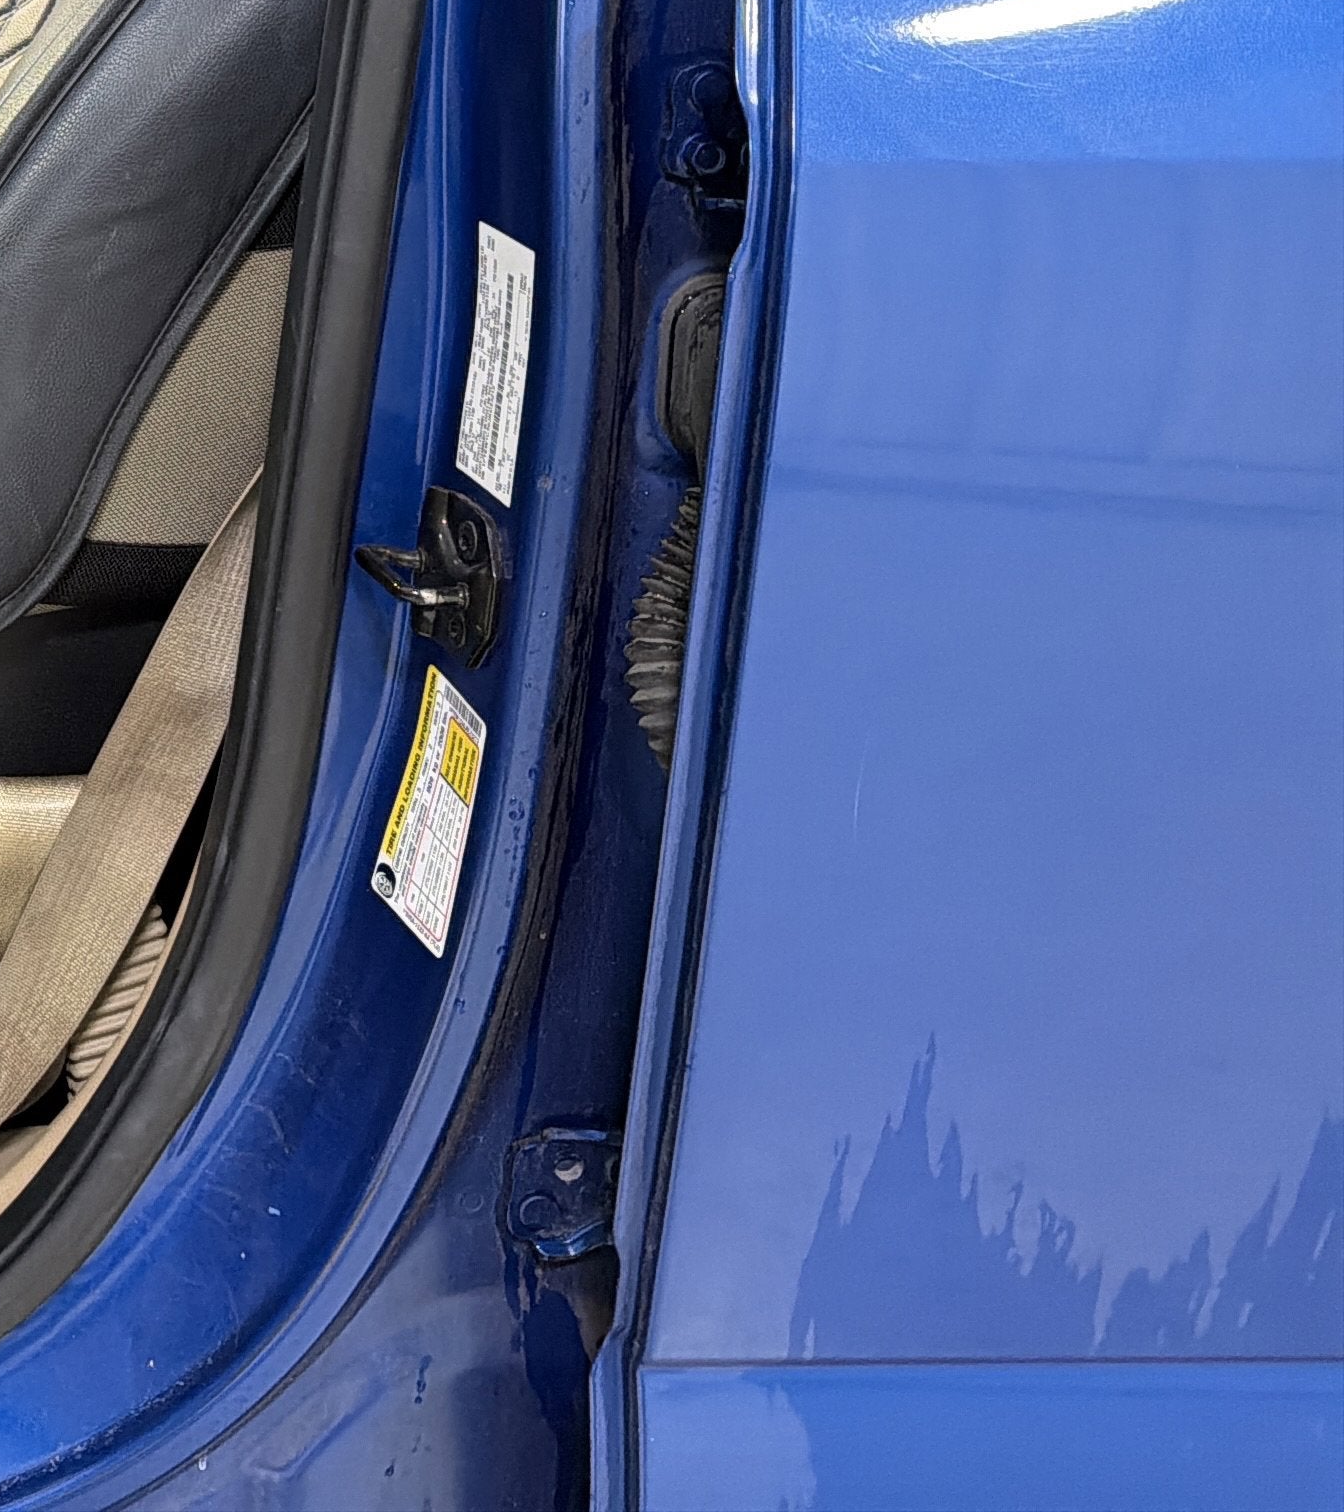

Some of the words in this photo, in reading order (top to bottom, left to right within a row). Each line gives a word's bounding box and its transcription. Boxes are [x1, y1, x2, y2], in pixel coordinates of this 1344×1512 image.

[385, 828, 396, 856] TIRE
[394, 802, 405, 829] AND
[402, 751, 420, 804] LOADING
[418, 672, 436, 750] INFORMATION
